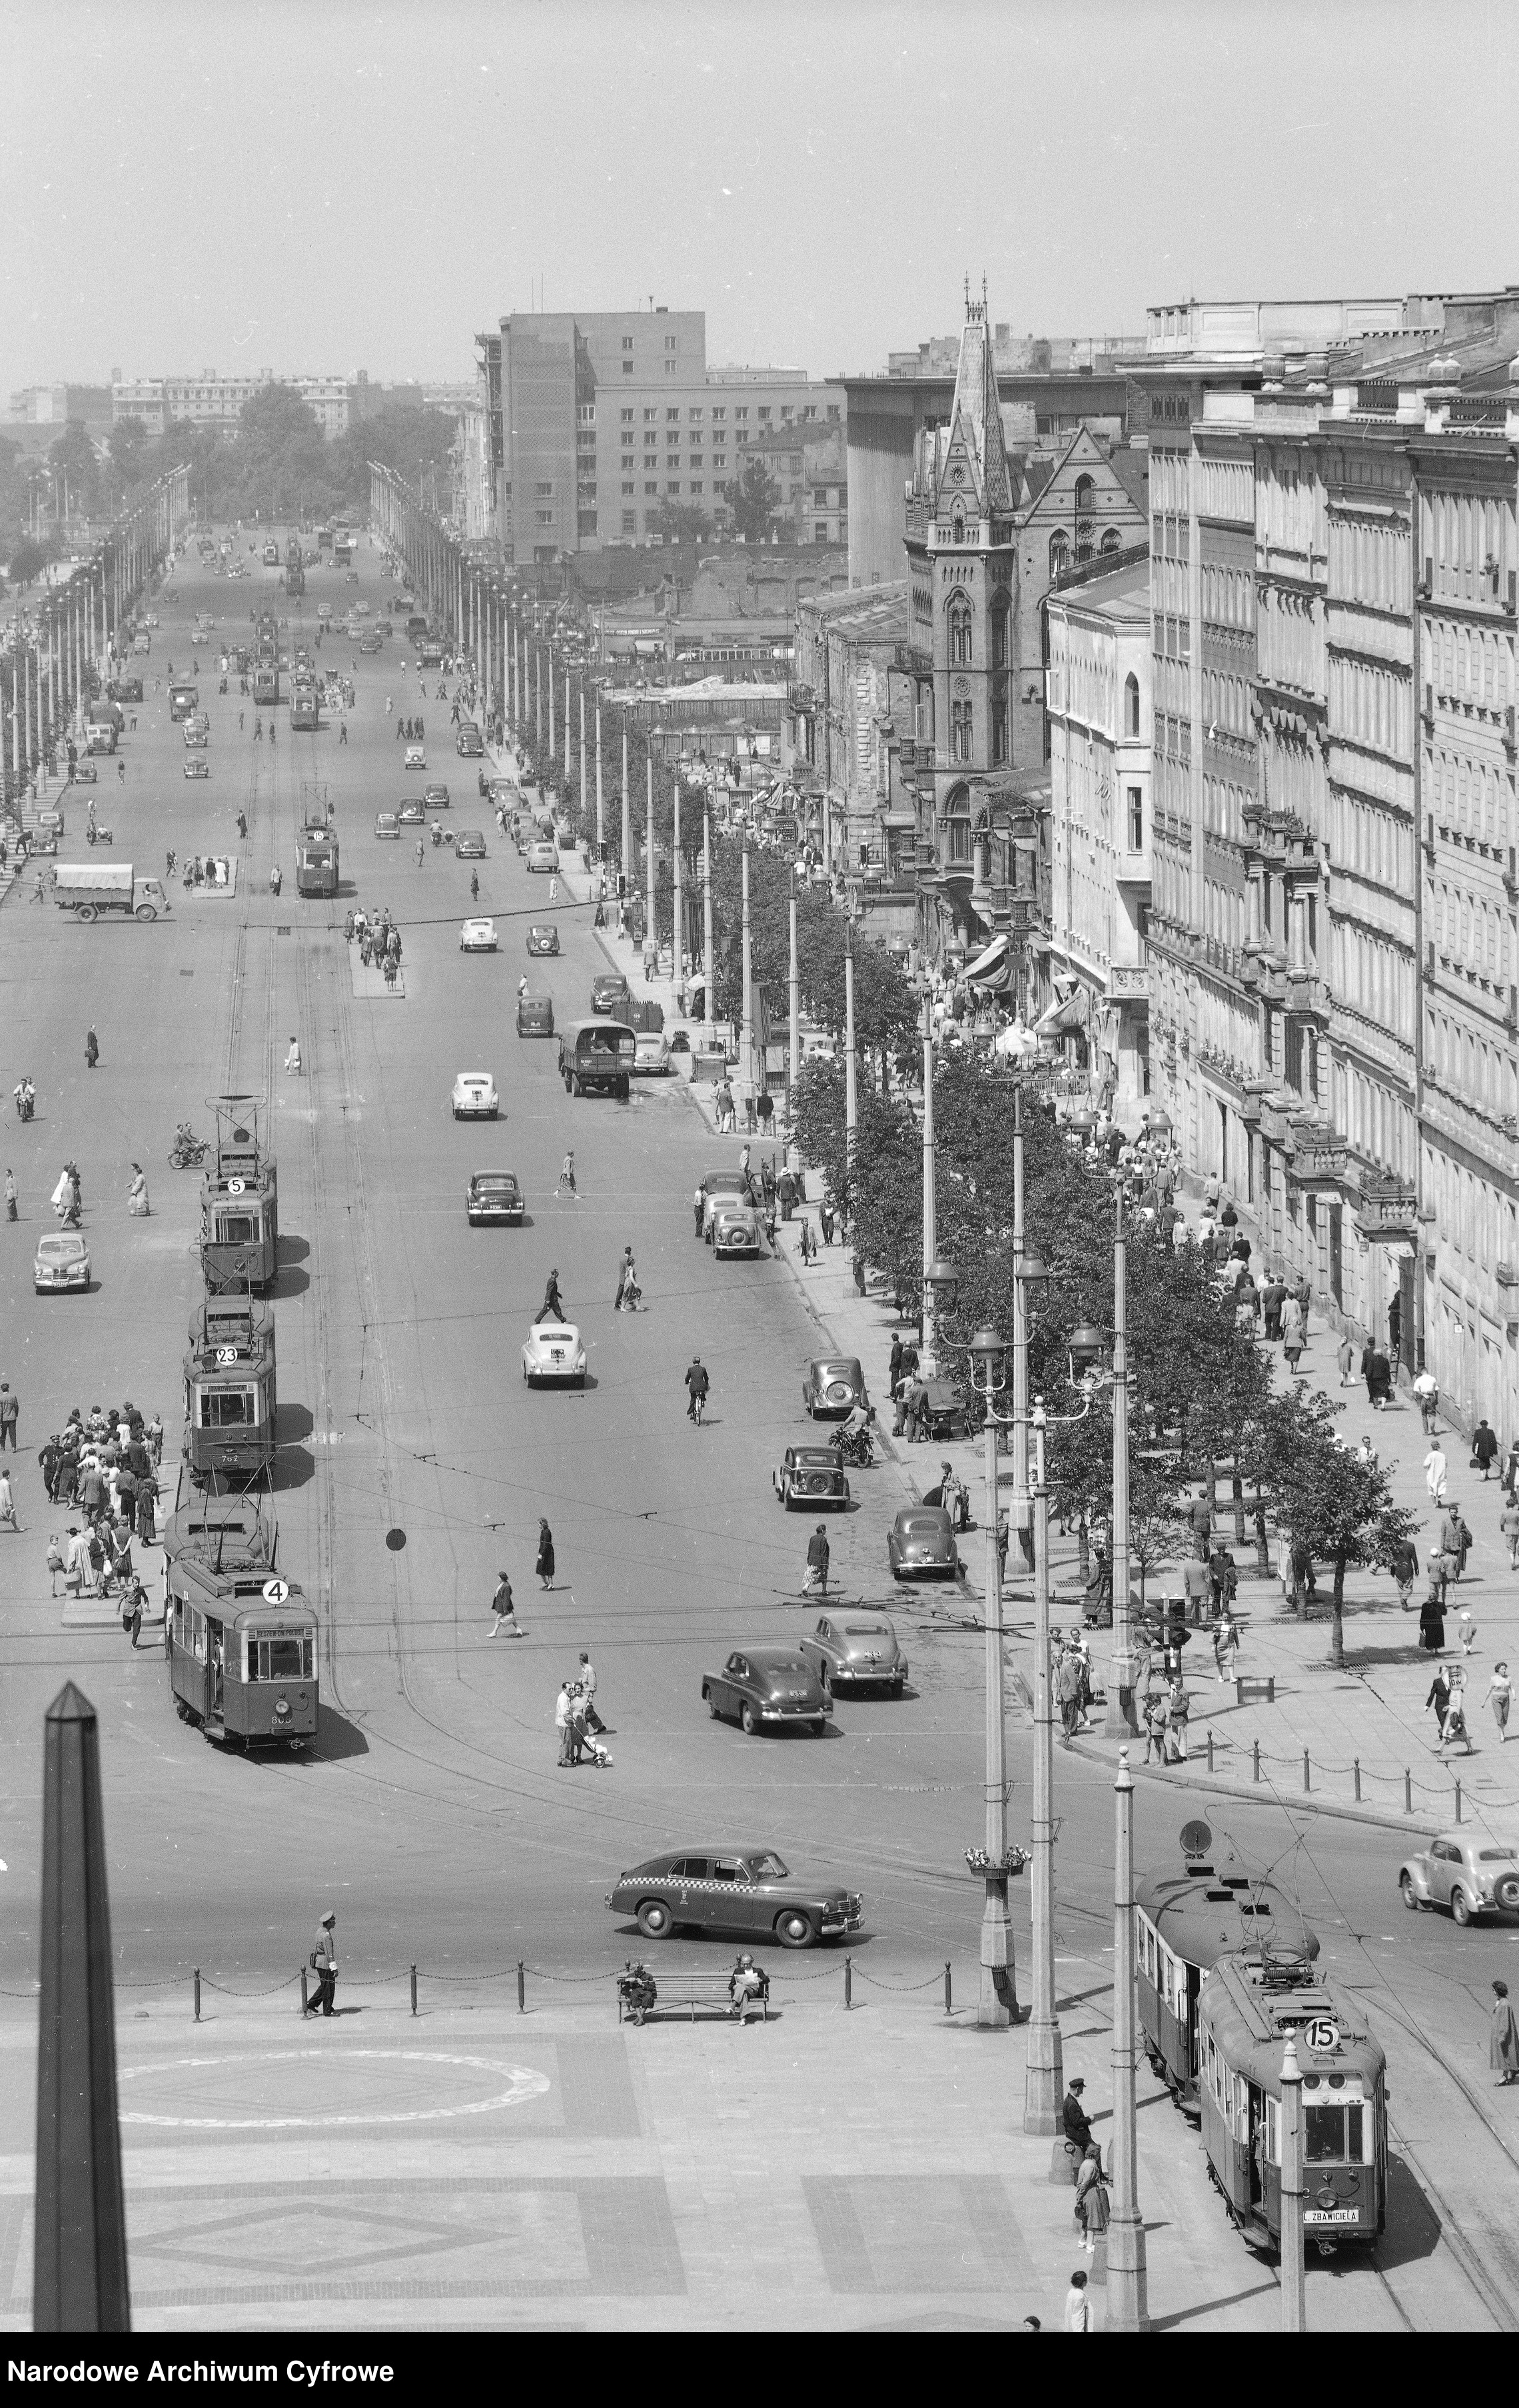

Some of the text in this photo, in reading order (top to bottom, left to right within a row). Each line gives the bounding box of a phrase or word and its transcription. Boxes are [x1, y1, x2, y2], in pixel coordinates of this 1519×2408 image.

[233, 1179, 241, 1191] 5
[219, 1348, 236, 1362] 23
[268, 1582, 282, 1601] 4
[1311, 2021, 1334, 2046] 15
[1312, 2212, 1356, 2221] ZBAWICIELA
